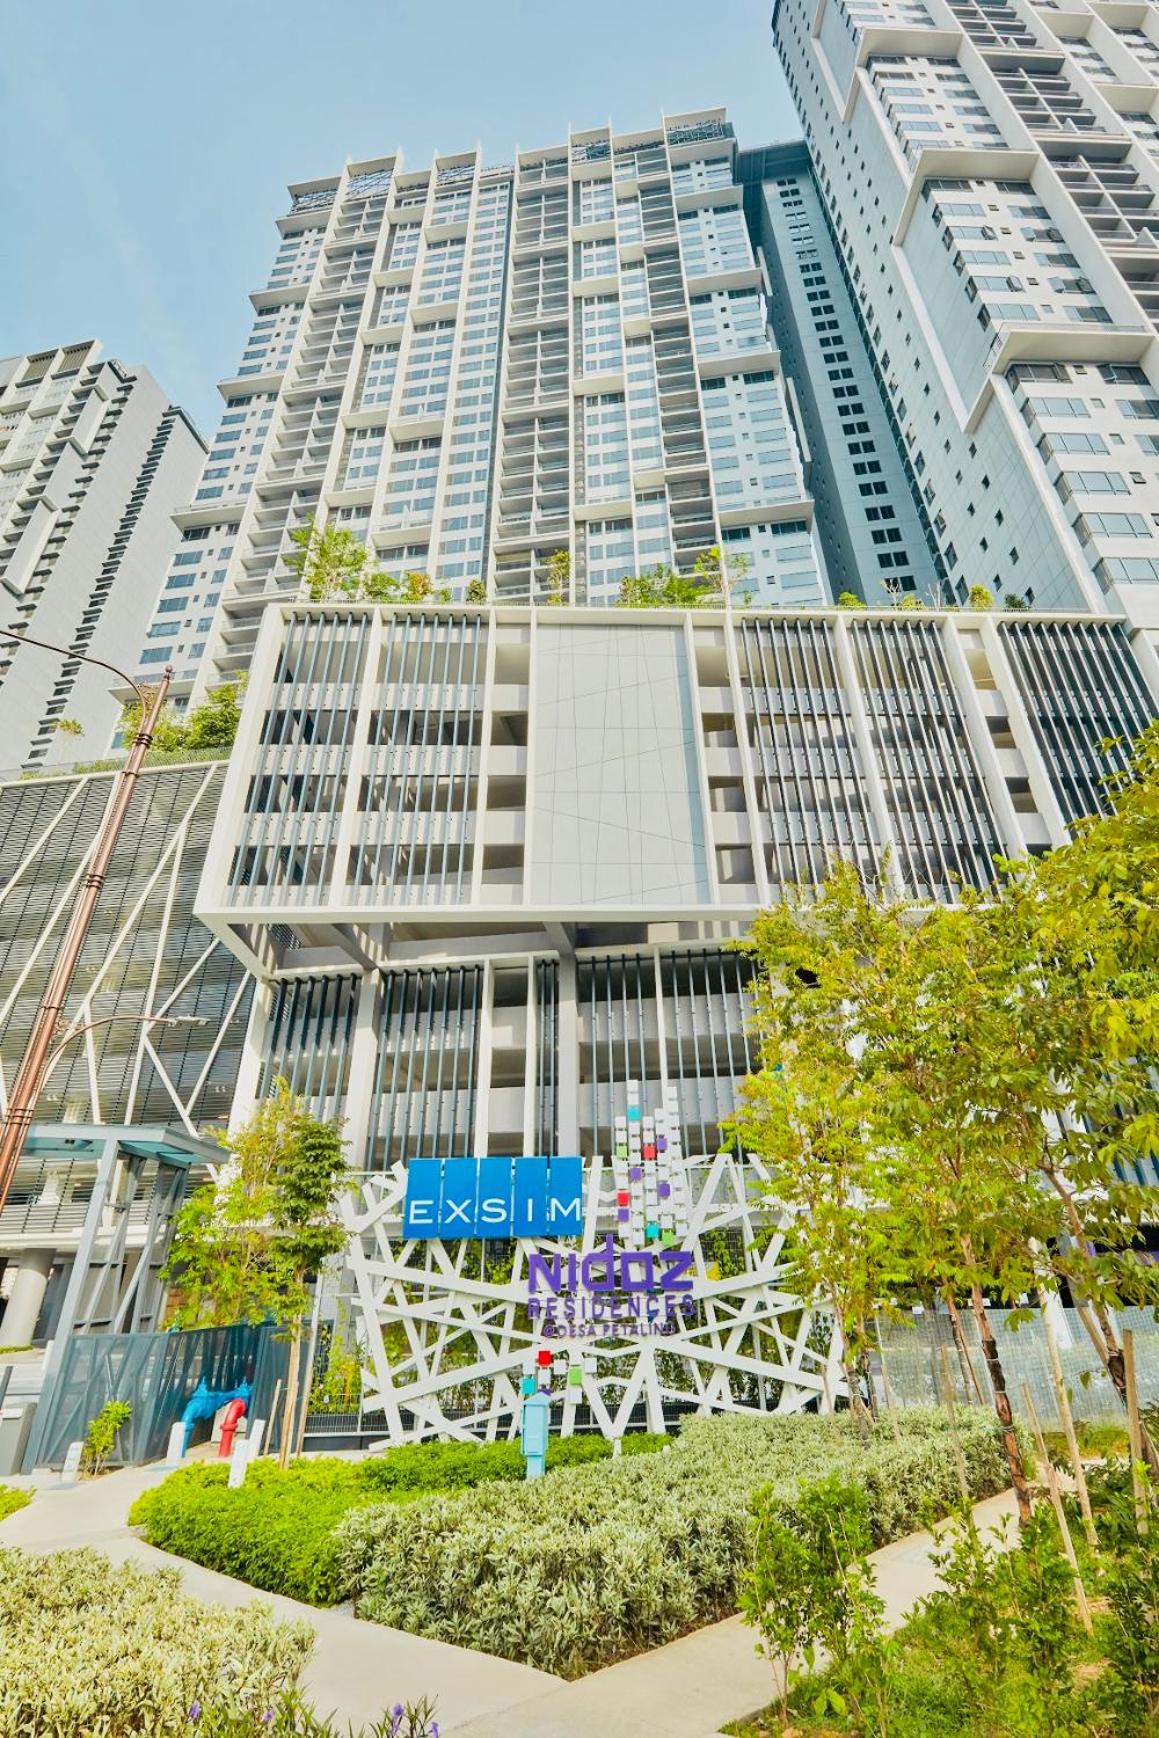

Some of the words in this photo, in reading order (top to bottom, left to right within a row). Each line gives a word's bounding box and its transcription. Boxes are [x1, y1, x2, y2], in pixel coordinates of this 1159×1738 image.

[409, 1197, 581, 1224] EXSIM
[528, 1294, 695, 1320] RESIDENCES
[543, 1324, 597, 1338] @DESA
